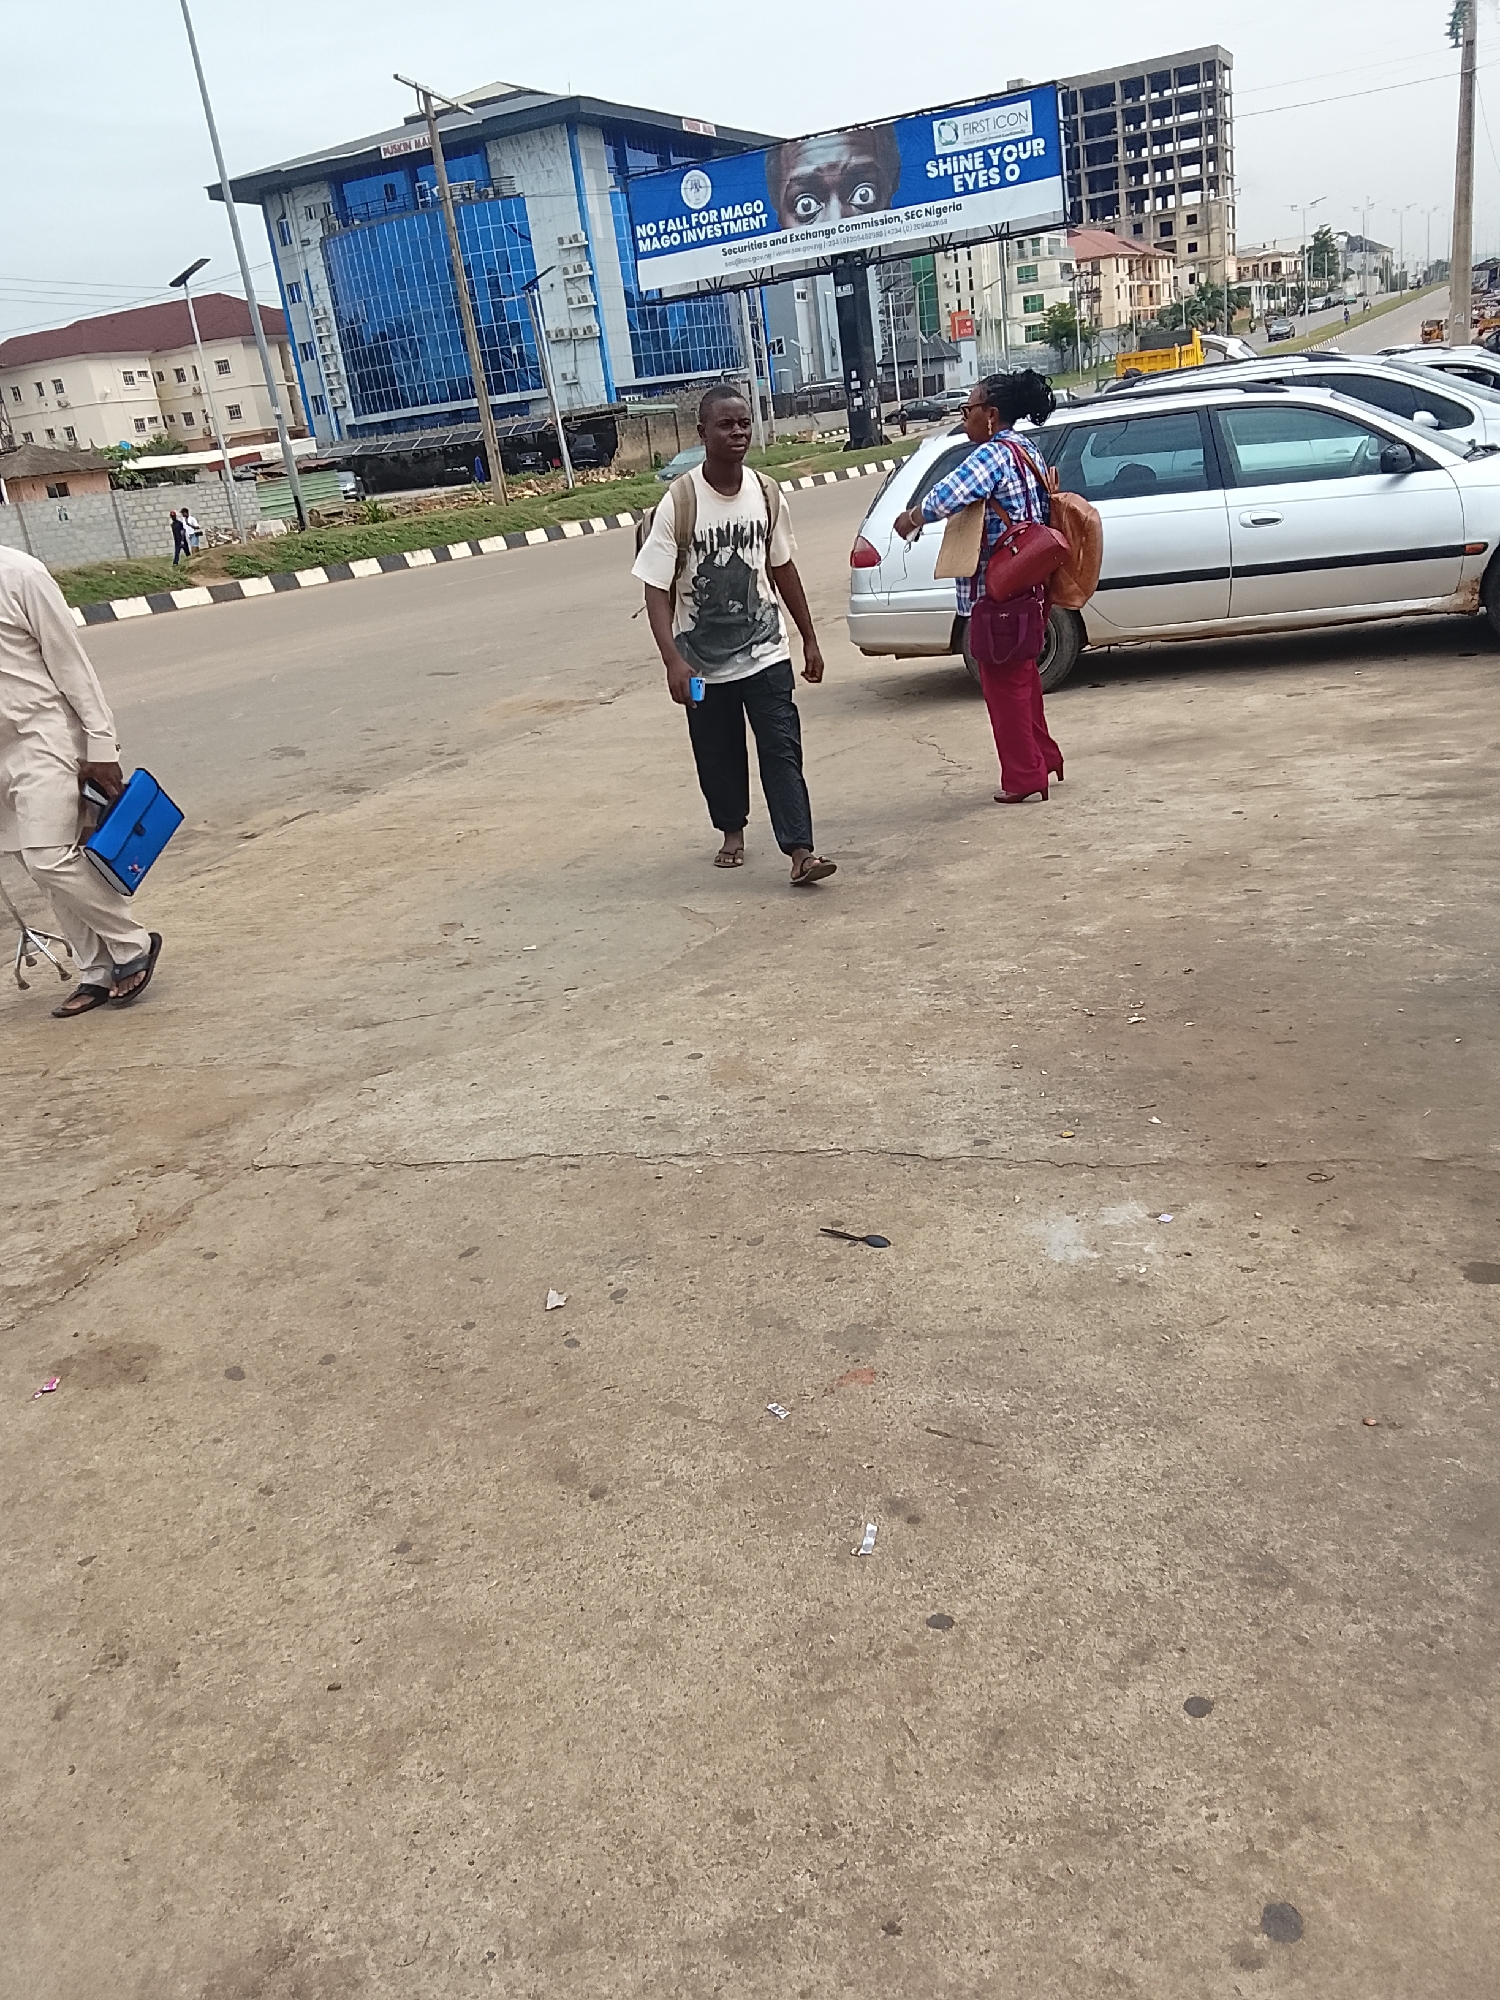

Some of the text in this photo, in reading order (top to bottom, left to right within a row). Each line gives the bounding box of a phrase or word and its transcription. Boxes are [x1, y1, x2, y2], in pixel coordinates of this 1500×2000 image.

[963, 110, 1029, 136] FIRST ICON
[926, 150, 985, 178] SHINE
[987, 137, 1045, 166] YOUR
[953, 163, 1020, 192] EYES O
[636, 200, 764, 238] NO FALL FOR MAGO
[638, 213, 768, 252] MAGO INVESTMENT
[721, 239, 768, 257] Securities
[769, 235, 787, 247] and
[789, 227, 836, 243] Exchange
[838, 213, 904, 233] Commission,
[904, 208, 923, 221] SEC
[924, 201, 963, 218] Nigeria
